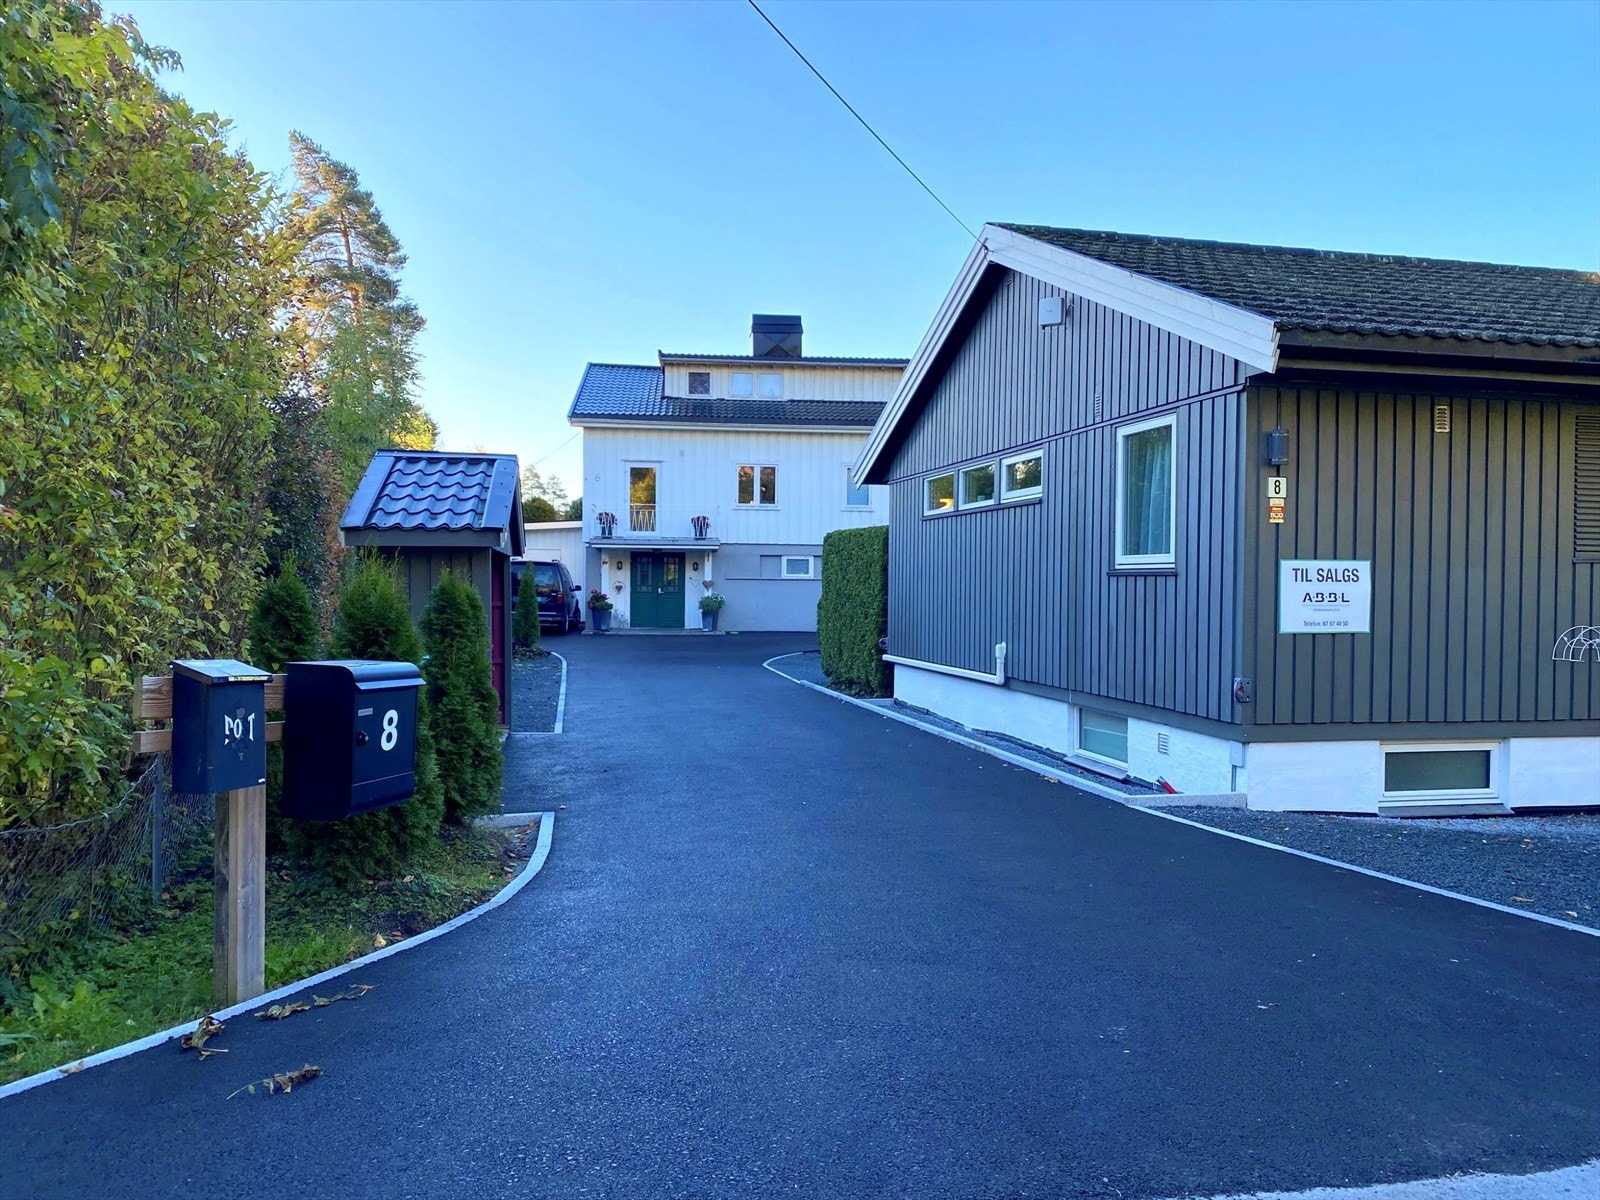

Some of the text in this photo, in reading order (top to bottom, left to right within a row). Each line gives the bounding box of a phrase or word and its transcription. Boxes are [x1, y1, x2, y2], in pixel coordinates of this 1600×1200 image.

[1274, 479, 1281, 495] 8
[1292, 567, 1360, 583] TIL SALGS
[381, 709, 399, 751] 8
